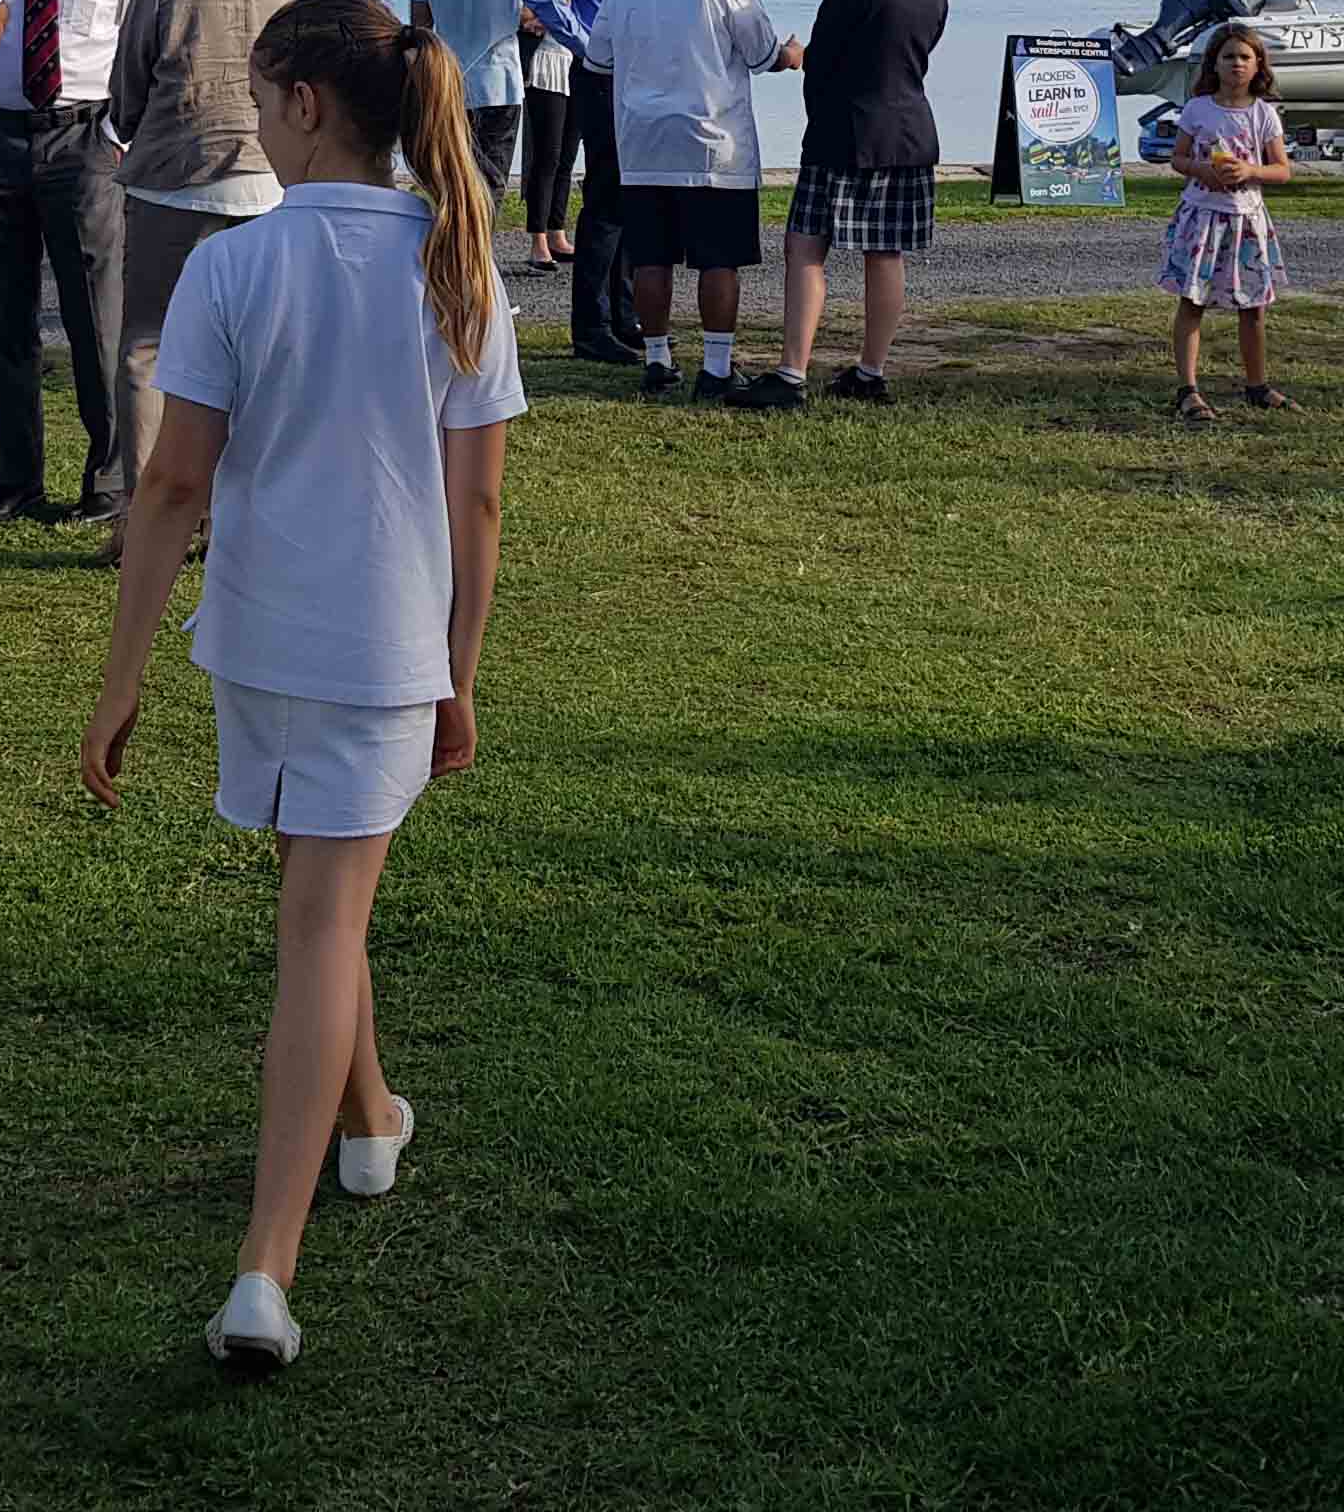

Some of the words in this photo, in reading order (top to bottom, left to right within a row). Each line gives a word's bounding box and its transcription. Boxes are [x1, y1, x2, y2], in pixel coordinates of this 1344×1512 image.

[1031, 70, 1076, 84] TACKERS
[1029, 87, 1071, 102] LEARN
[1074, 87, 1086, 98] to
[1048, 183, 1071, 198] $20
